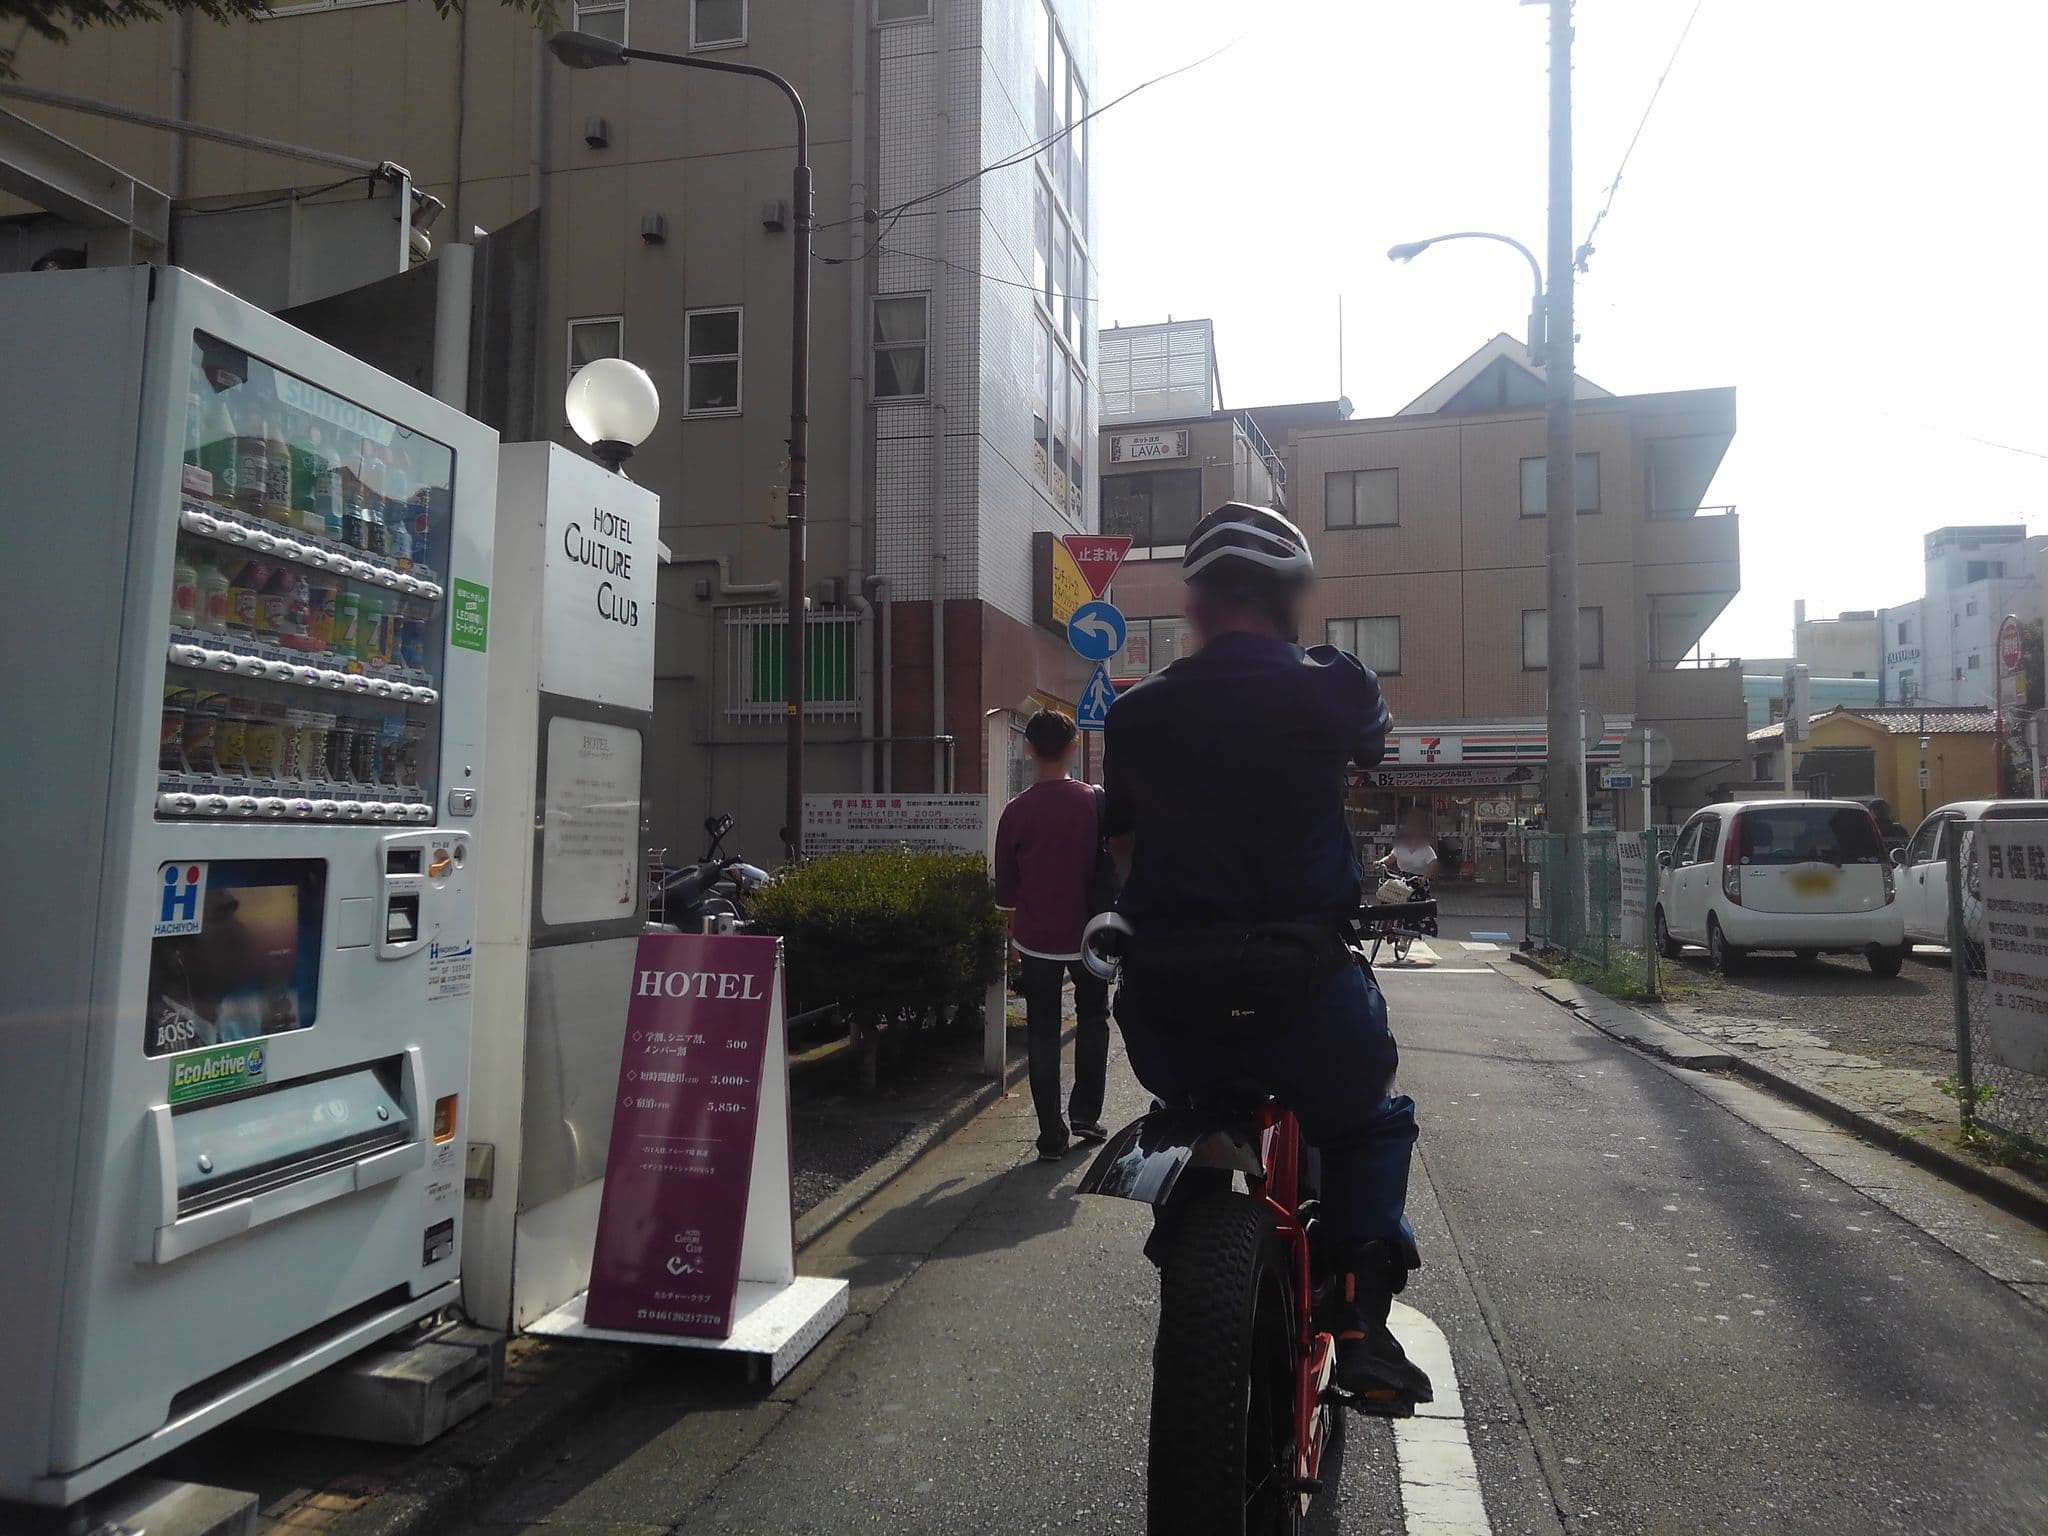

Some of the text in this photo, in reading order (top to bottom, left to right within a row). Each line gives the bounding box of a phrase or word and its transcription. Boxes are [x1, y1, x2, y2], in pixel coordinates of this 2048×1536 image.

[1131, 445, 1161, 458] LAVA
[593, 507, 632, 544] HOTEL
[564, 522, 632, 580] CULTURE
[1077, 547, 1120, 562] 止まれ
[597, 581, 638, 627] CLUB
[832, 799, 902, 809] 有料駐車場
[637, 970, 763, 1000] HOTEL
[156, 1019, 196, 1046] BOSS
[725, 1039, 748, 1049] 500
